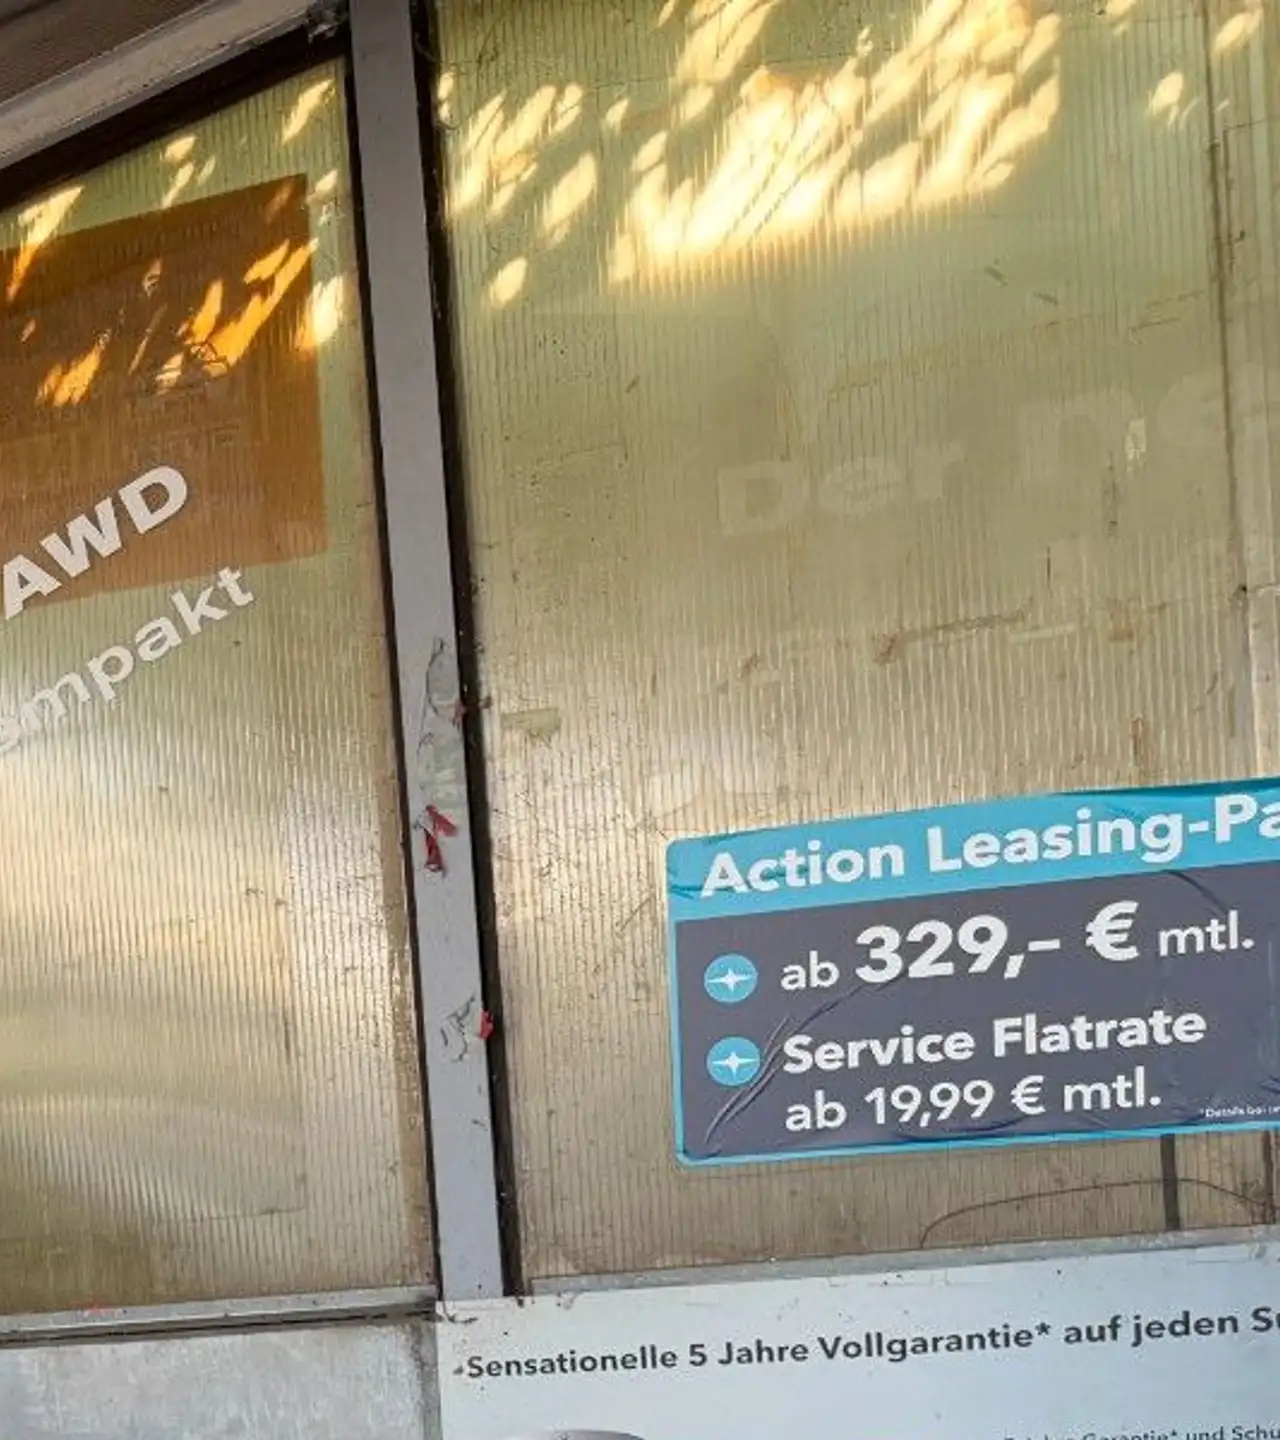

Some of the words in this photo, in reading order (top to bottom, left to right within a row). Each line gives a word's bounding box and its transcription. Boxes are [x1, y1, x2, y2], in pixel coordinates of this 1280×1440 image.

[1, 465, 188, 620] AWD
[700, 840, 905, 898] Action
[781, 950, 840, 990] ab
[855, 914, 1060, 984] 329,-
[1085, 900, 1139, 961] €
[1159, 910, 1255, 957] mtl.
[783, 1024, 976, 1074] Service
[993, 1010, 1207, 1057] Flatrate
[785, 1089, 847, 1132] ab
[864, 1079, 995, 1128] 19,99
[1011, 1075, 1045, 1115] €
[1064, 1065, 1161, 1112] mtl.
[467, 1345, 677, 1378] Sensationelle
[689, 1344, 708, 1366] 5
[718, 1339, 809, 1365] Jahre
[1063, 1315, 1122, 1344] auf
[1132, 1310, 1239, 1347] jeden
[1251, 1306, 1280, 1333] S
